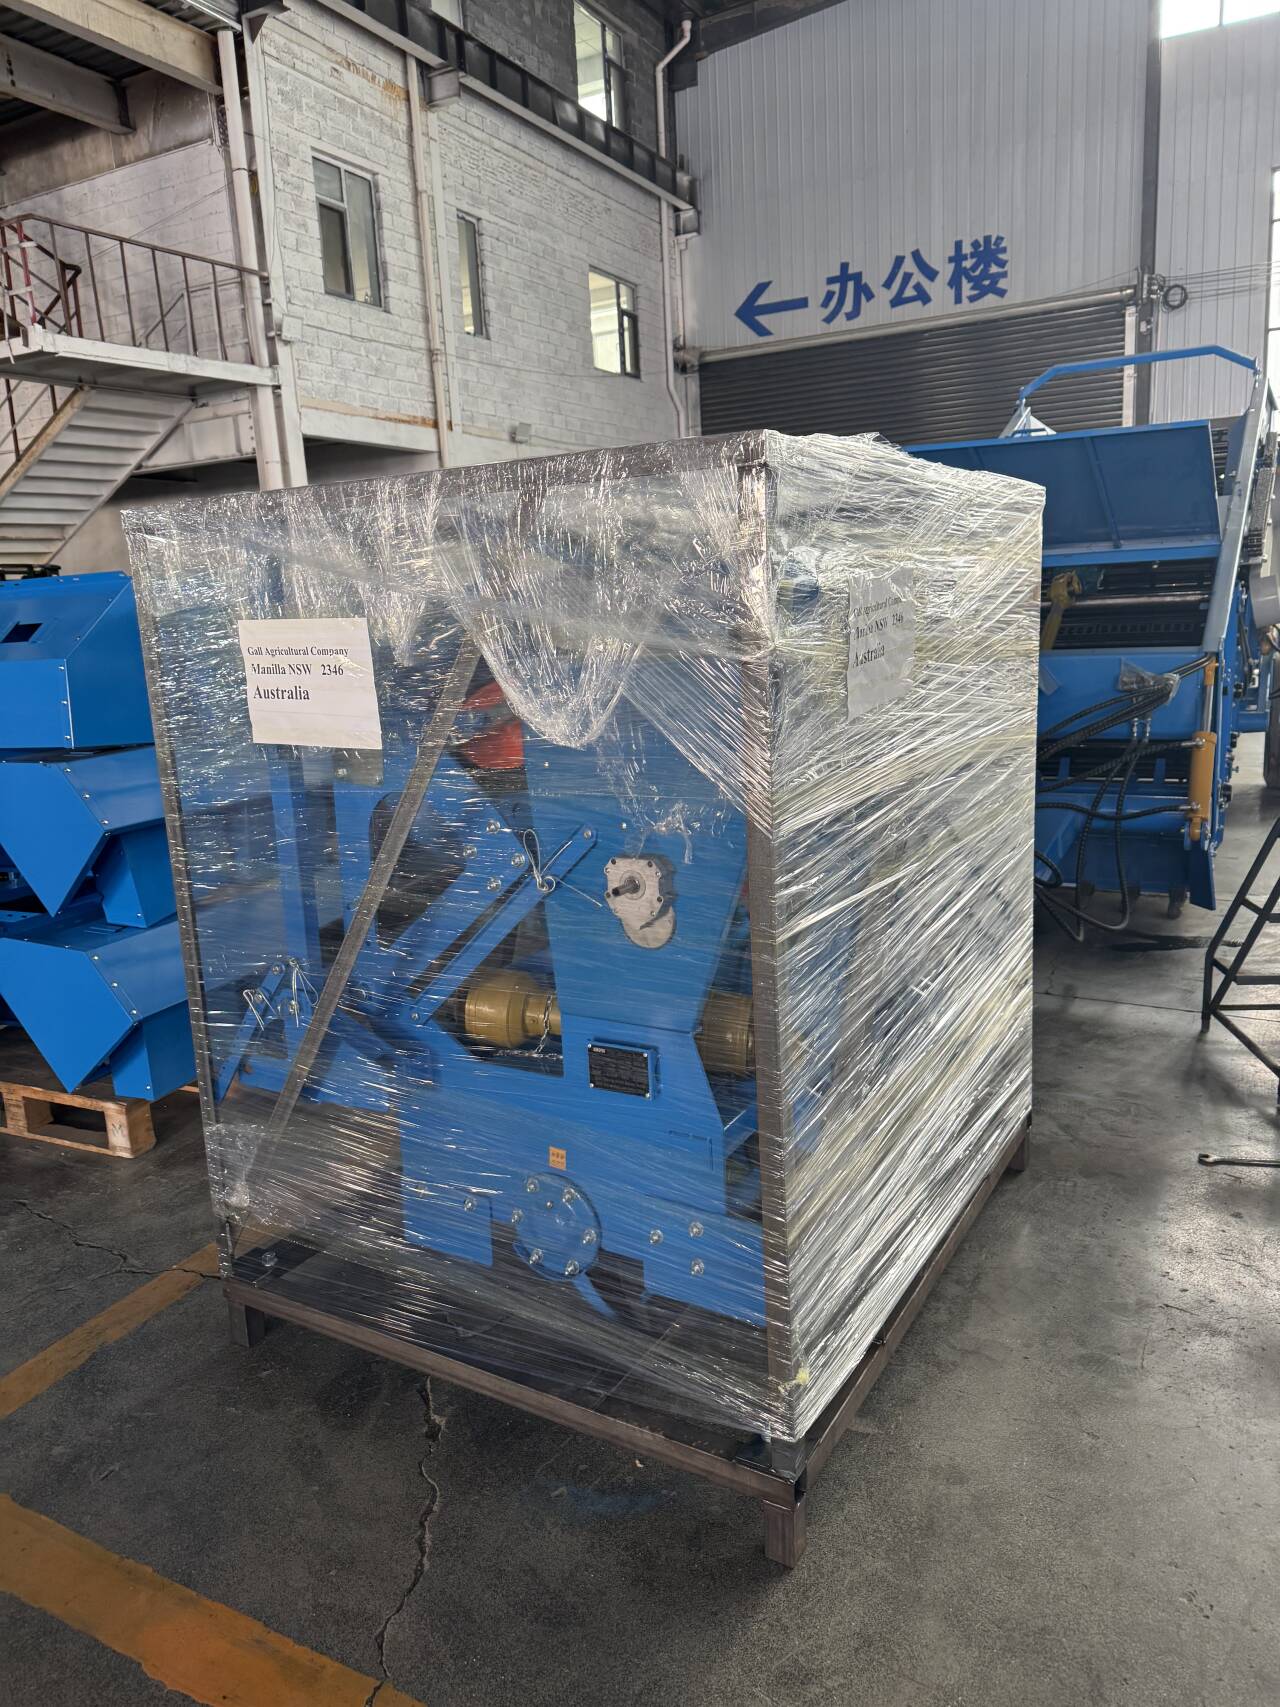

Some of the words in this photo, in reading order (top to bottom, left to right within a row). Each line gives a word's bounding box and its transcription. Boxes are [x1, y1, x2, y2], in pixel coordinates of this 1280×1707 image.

[819, 234, 1009, 325] 办公楼
[247, 646, 263, 656] Gall
[265, 646, 309, 657] Agricultural
[310, 646, 349, 657] Company
[251, 663, 286, 675] Manilla
[288, 663, 312, 675] NSW
[320, 664, 344, 676] 2346
[253, 685, 310, 700] Australia
